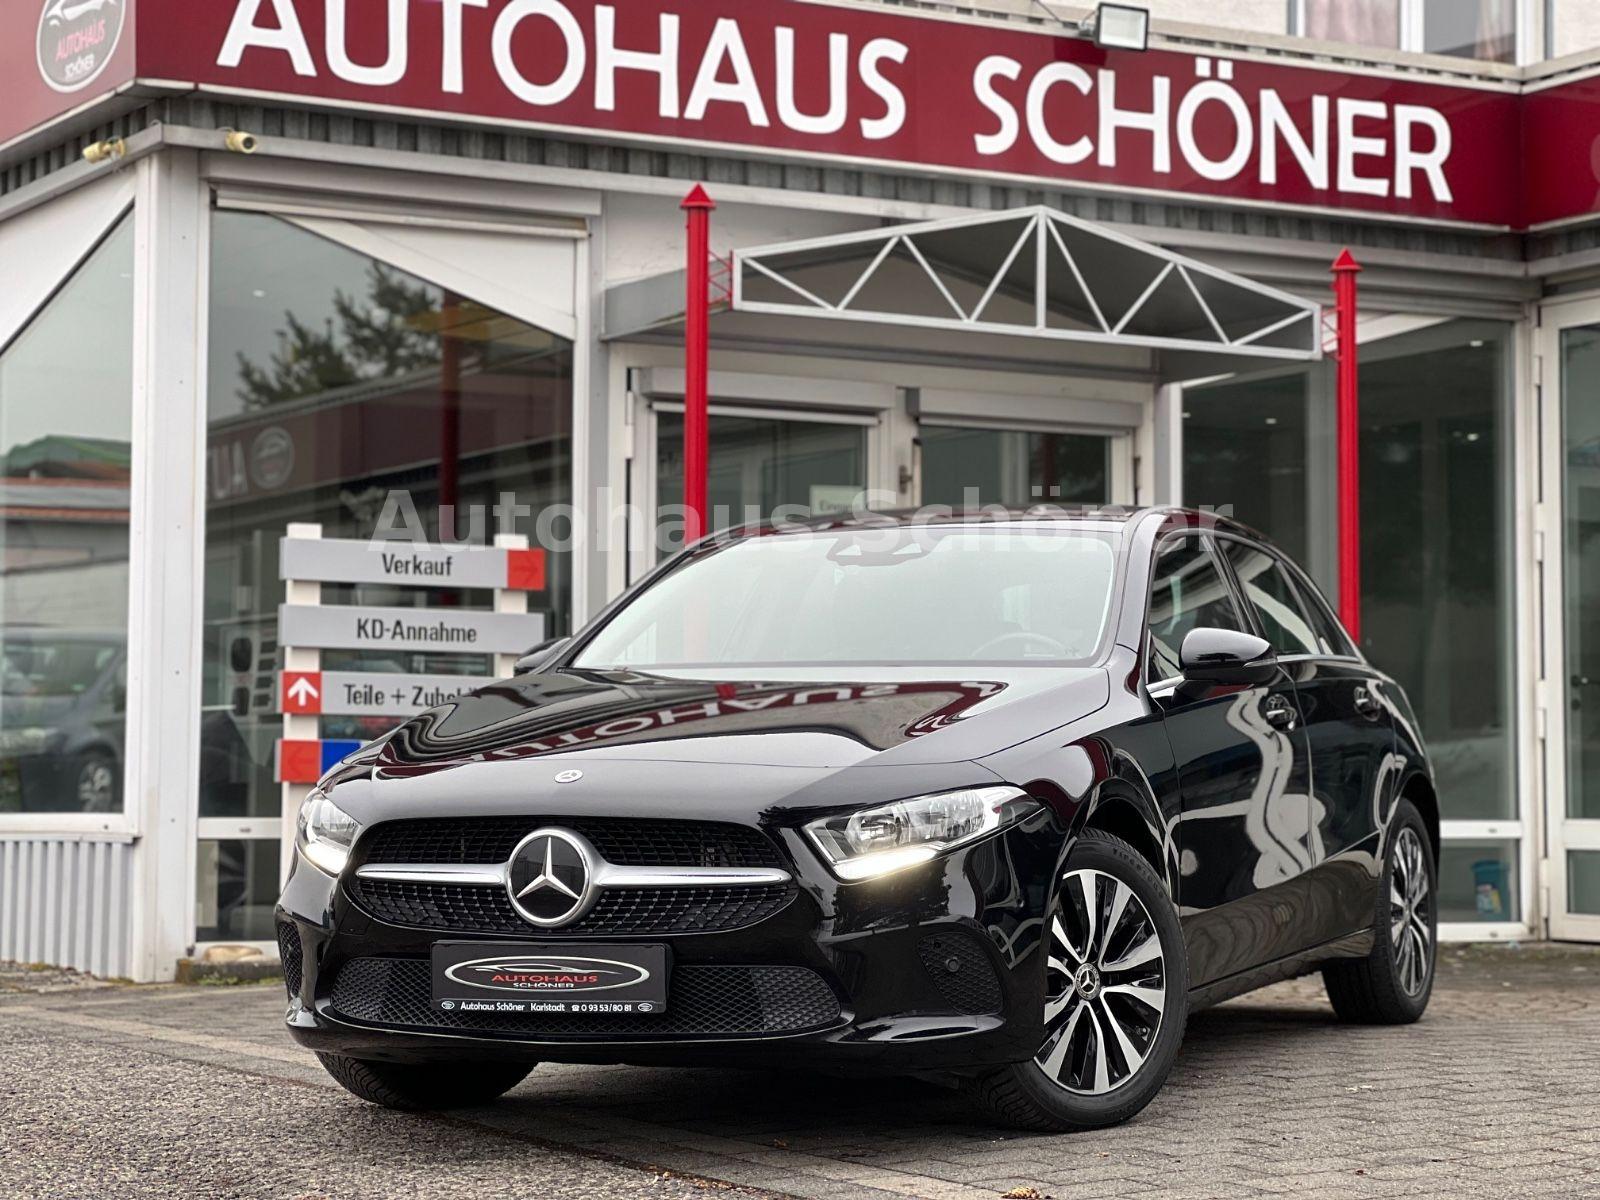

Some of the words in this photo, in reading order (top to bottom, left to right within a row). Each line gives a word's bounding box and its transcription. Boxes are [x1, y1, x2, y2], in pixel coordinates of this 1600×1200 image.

[55, 19, 106, 62] AUTOHAUS
[216, 0, 909, 140] AUTOHAUS
[973, 57, 1453, 204] SCHÖNER
[382, 553, 453, 577] Verkauf
[356, 618, 477, 643] KD-Annahme
[343, 684, 385, 706] Teile
[491, 974, 599, 983] AUTOHAUS
[460, 1001, 495, 1011] Autohaus
[496, 1001, 525, 1011] Schöner
[530, 1002, 566, 1012] Karlstadt
[581, 1004, 587, 1012] 0
